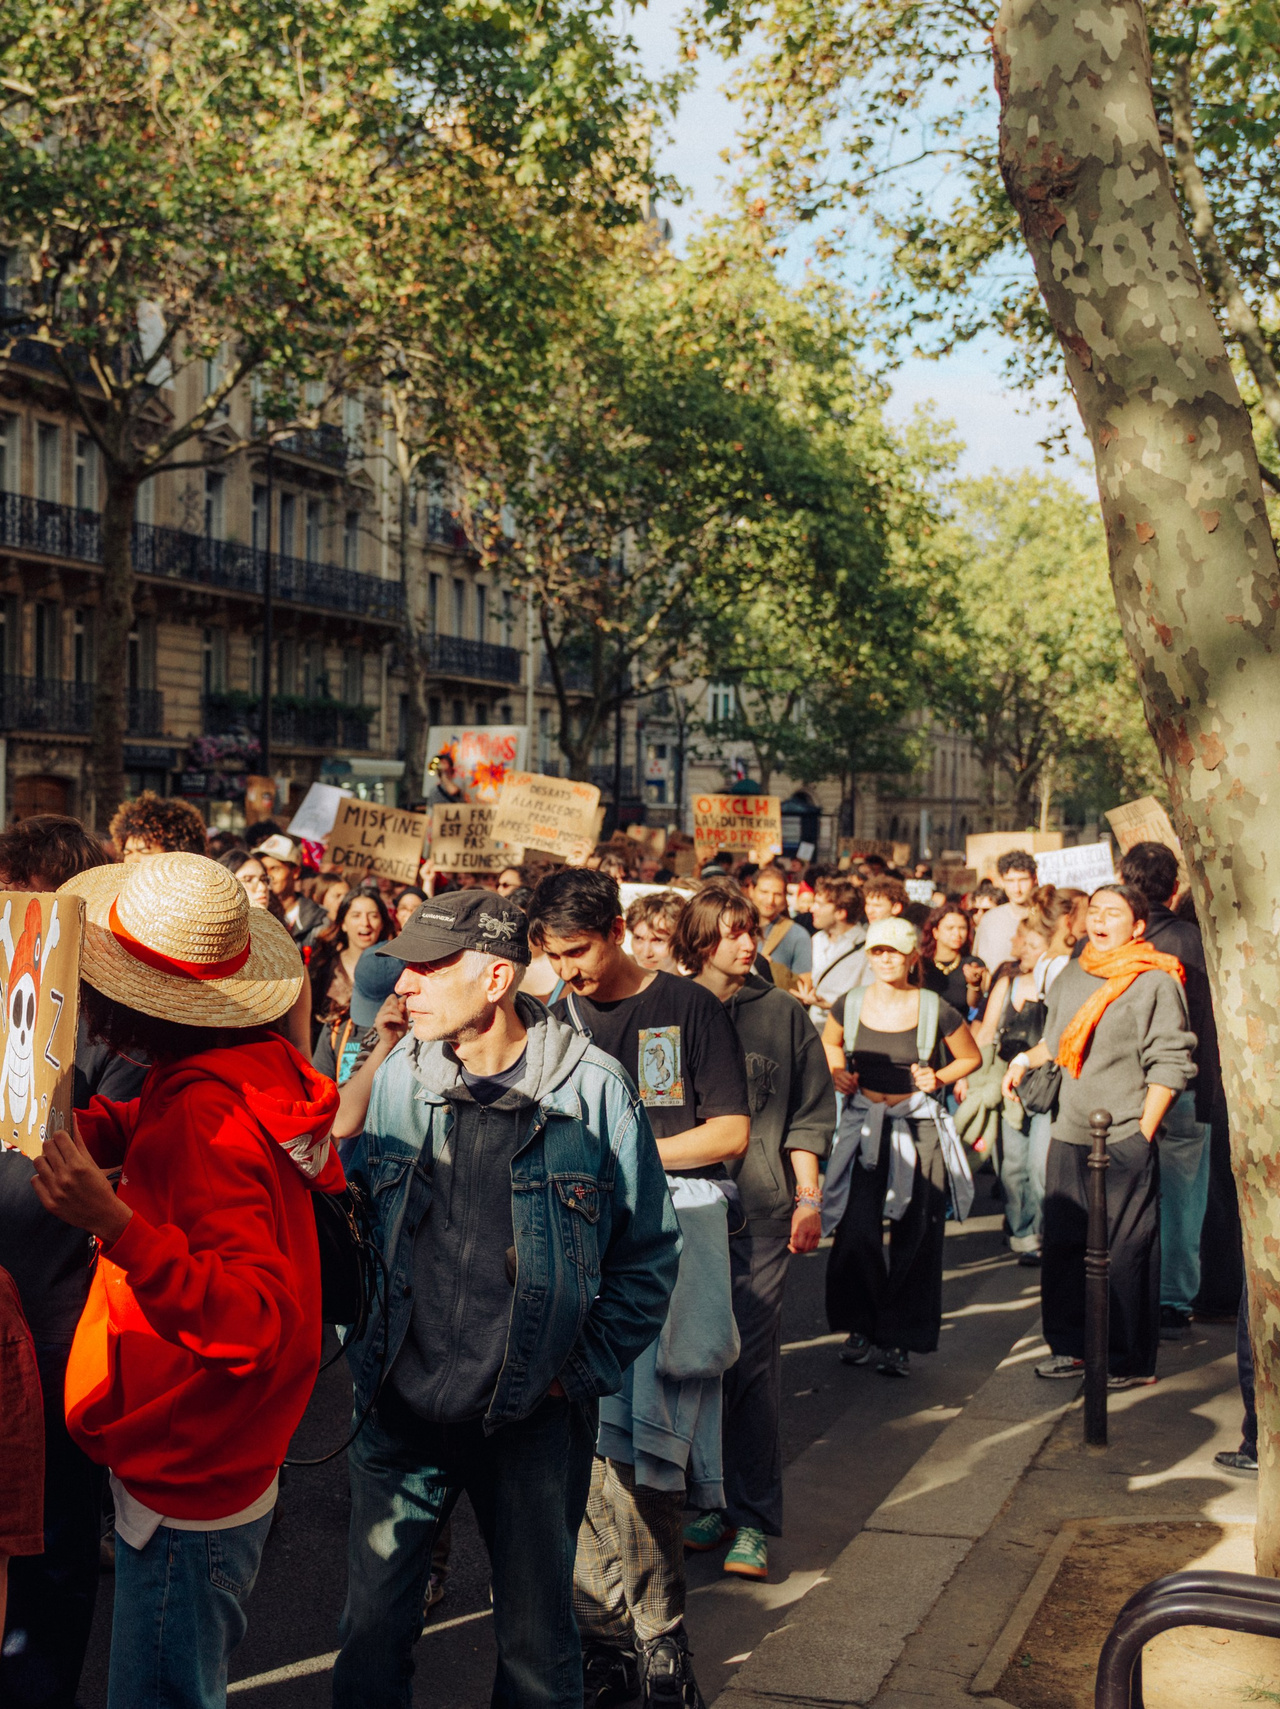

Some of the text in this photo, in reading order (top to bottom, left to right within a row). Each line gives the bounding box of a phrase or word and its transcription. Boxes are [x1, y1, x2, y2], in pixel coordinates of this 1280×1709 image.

[343, 805, 423, 838] MISKINE
[444, 809, 497, 822] LA FRA
[528, 812, 559, 827] PROFS
[721, 816, 736, 827] DU
[440, 823, 493, 837] EST SOU
[706, 828, 727, 842] PAS
[360, 830, 385, 849] LA
[464, 837, 485, 849] PAS
[331, 843, 416, 880] DÉMOCRATIE
[433, 852, 518, 868] LA JEUNESSE
[43, 986, 65, 1071] Z
